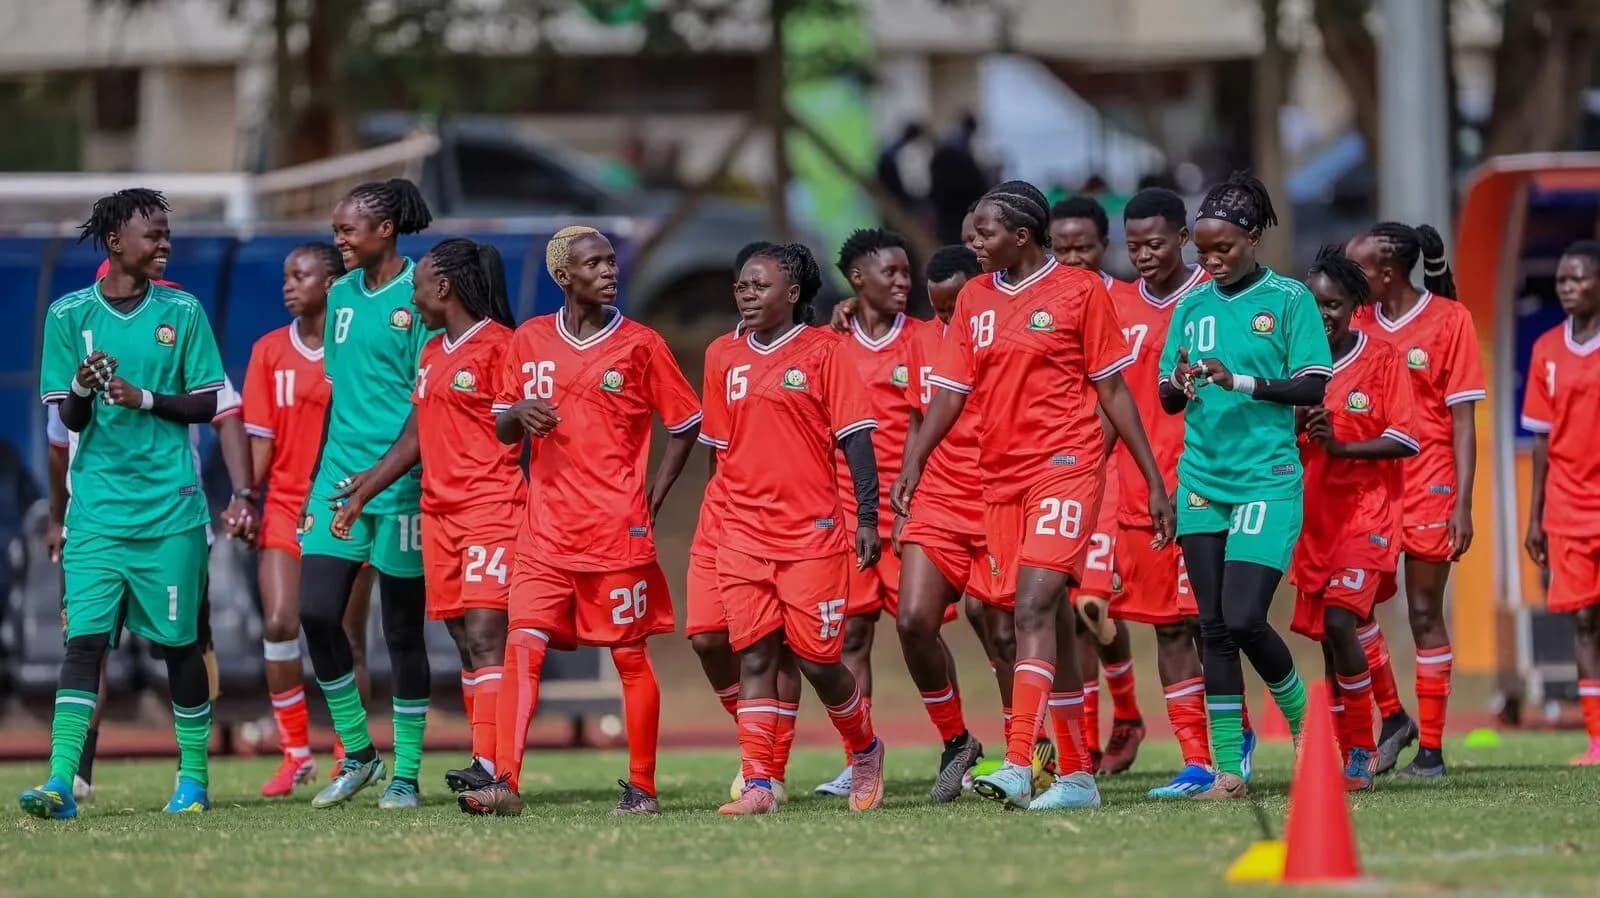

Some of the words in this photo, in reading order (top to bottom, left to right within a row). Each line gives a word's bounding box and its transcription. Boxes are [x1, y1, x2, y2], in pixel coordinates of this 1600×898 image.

[82, 329, 93, 356] 1
[335, 307, 354, 344] 8
[274, 369, 296, 407] 11
[522, 360, 555, 400] 26
[726, 364, 751, 405] 15
[1035, 498, 1082, 538] 28
[1229, 501, 1267, 535] 30
[465, 545, 507, 584] 24
[1086, 533, 1116, 571] 2
[167, 585, 177, 620] 1
[610, 580, 648, 625] 26
[818, 599, 845, 640] 15
